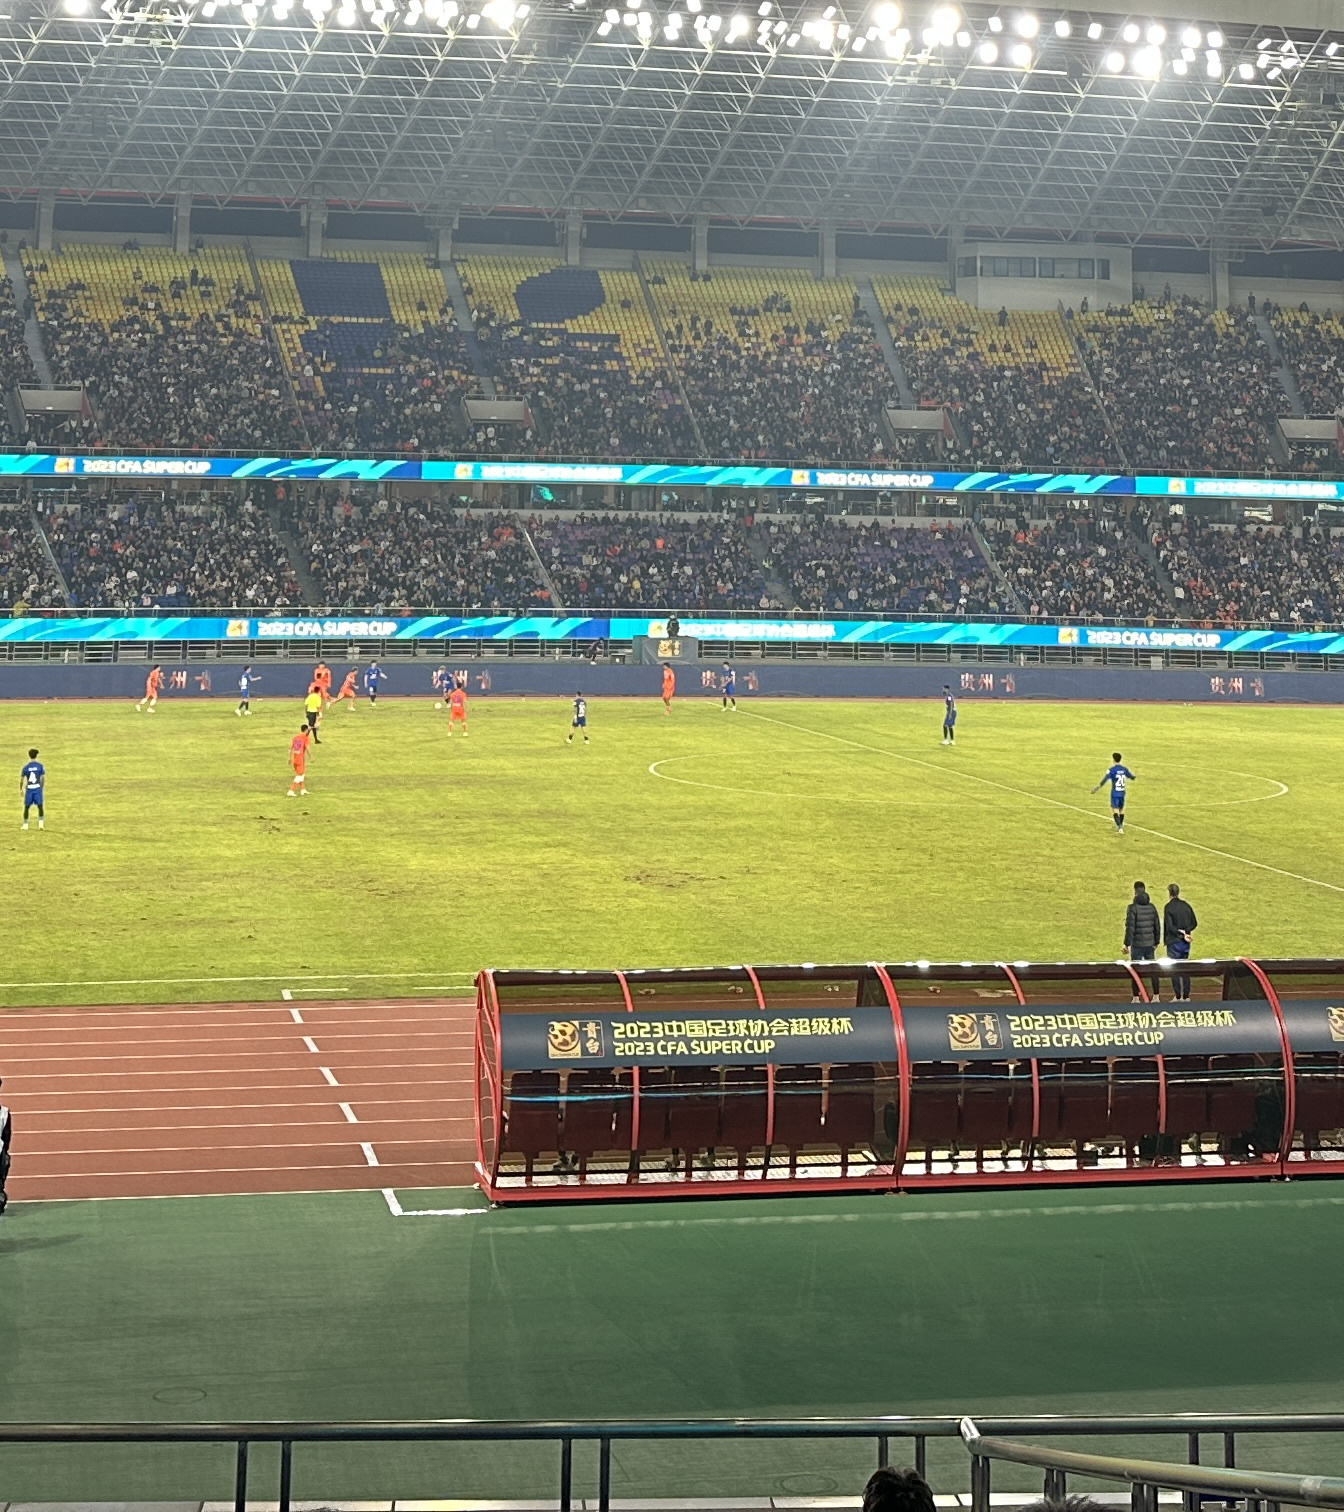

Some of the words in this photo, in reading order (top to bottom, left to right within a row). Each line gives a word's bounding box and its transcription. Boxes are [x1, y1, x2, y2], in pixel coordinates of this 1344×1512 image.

[117, 459, 142, 473] CFA
[143, 459, 186, 474] SUPER
[187, 460, 211, 474] CUP
[847, 472, 871, 486] CFA
[872, 472, 909, 486] SUPER
[910, 473, 934, 487] CUP
[294, 621, 322, 636] CFA
[323, 621, 368, 635] SUPER
[369, 621, 398, 635] CUP
[1122, 631, 1149, 646] CFA
[1150, 631, 1193, 646] SUPER
[1194, 633, 1220, 647] CUP
[610, 1017, 854, 1039] 2023中国足球协会超级杯
[1006, 1010, 1236, 1031] 2023中国足球协会超级杯
[612, 1040, 655, 1057] 2023
[656, 1040, 687, 1056] CFA
[690, 1039, 743, 1055] SUPER
[744, 1038, 775, 1054] CUP
[1010, 1033, 1050, 1048] 2023
[1052, 1032, 1082, 1048] CFA
[1085, 1031, 1135, 1047] SUPER
[1136, 1030, 1164, 1045] CUP
